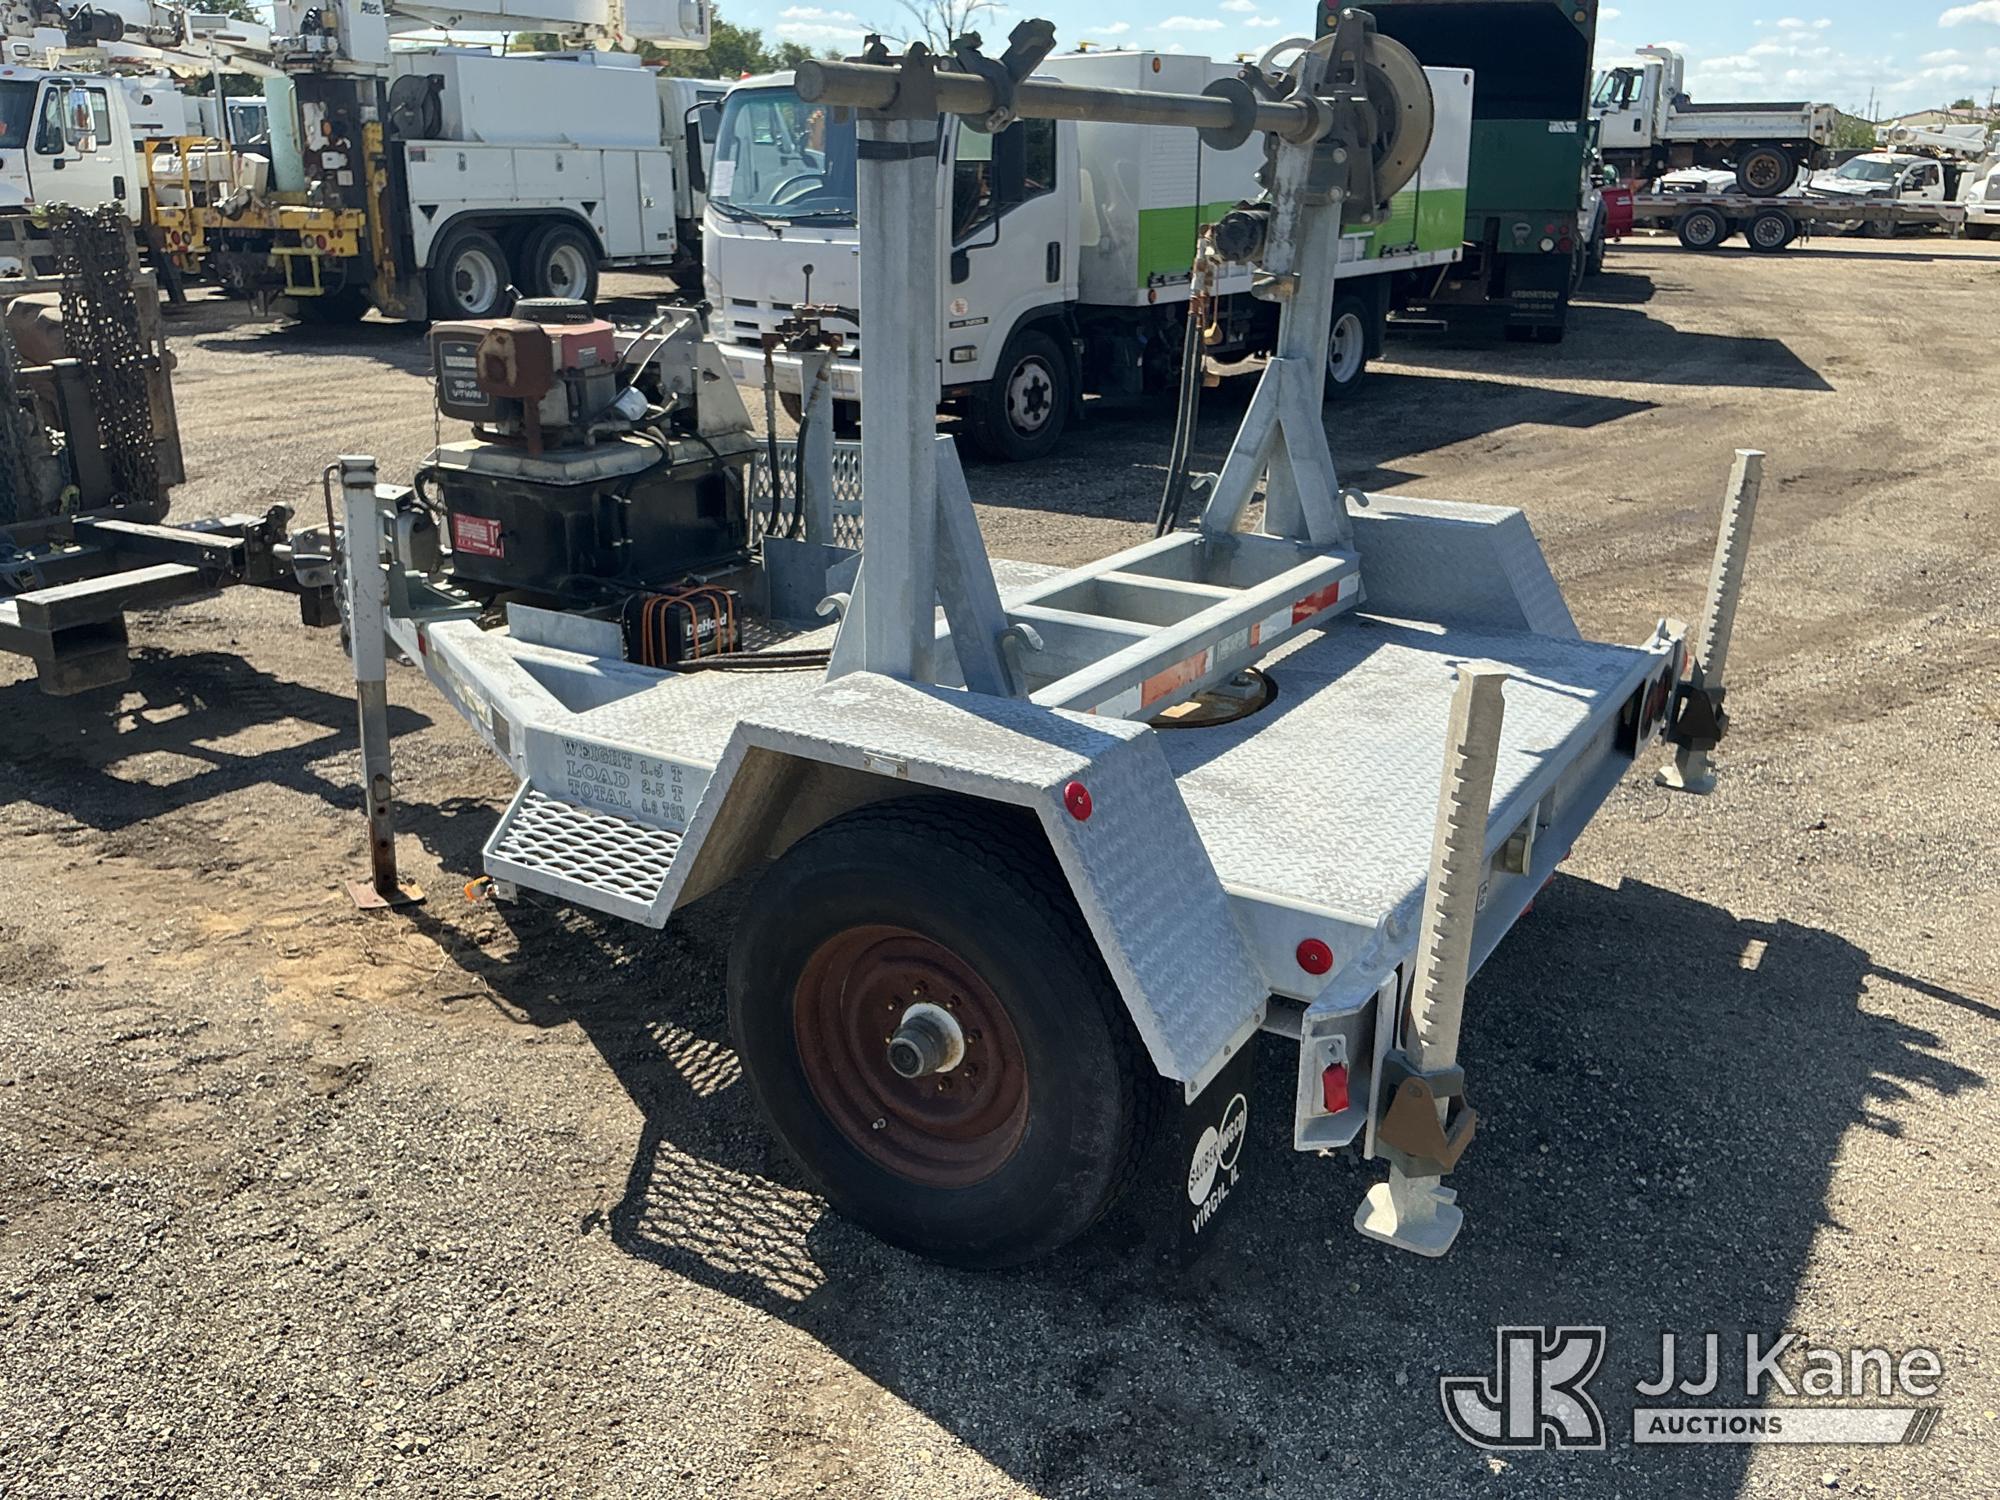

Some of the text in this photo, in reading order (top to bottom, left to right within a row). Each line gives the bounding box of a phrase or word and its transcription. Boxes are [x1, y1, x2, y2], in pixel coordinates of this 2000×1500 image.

[686, 612, 727, 637] DeHad
[562, 738, 683, 783] WEIGHT 1.5 T
[566, 760, 684, 803] LOAD 2.5 T
[568, 778, 632, 808] TOTAL
[1230, 1164, 1240, 1187] IL
